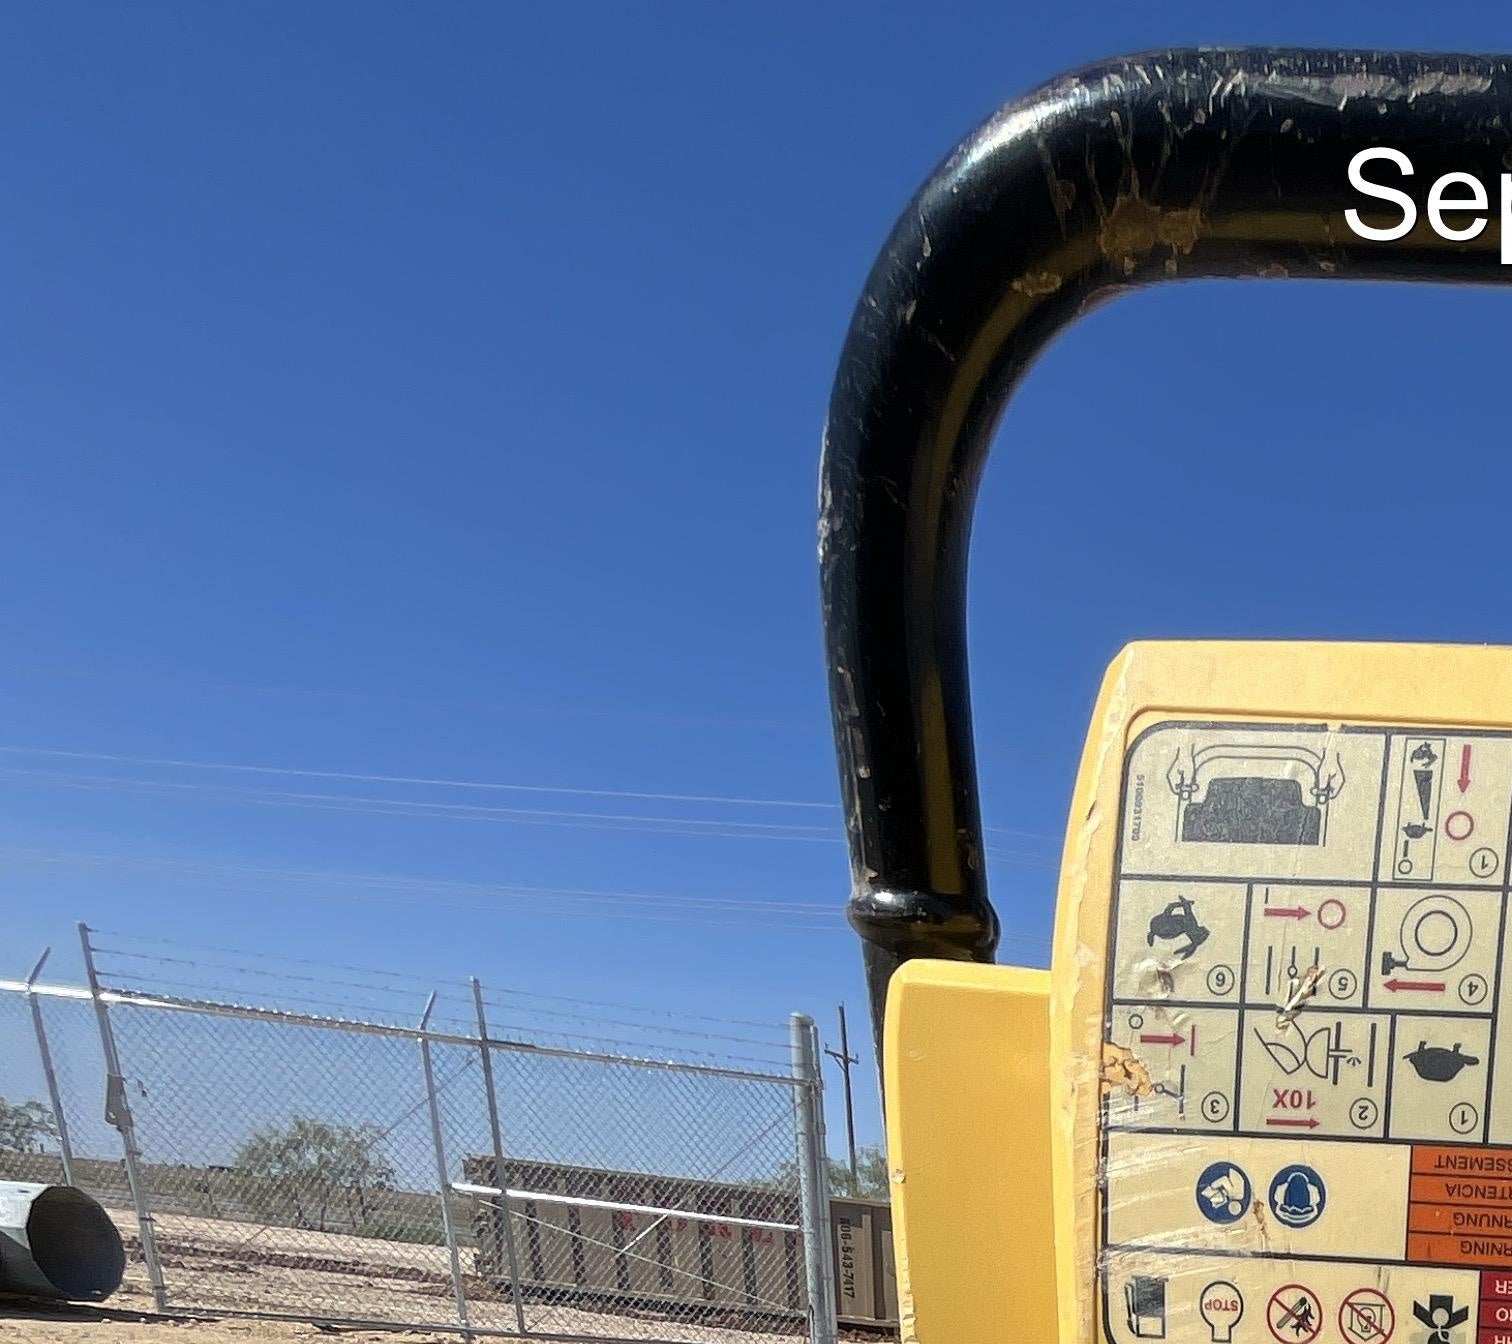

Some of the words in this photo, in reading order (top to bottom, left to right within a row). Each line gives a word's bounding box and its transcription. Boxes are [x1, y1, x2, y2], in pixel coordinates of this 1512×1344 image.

[1215, 973, 1225, 987] 6
[1337, 976, 1348, 991] 5
[1467, 981, 1479, 997] 4
[1272, 1087, 1317, 1110] 10X
[1209, 1099, 1220, 1114] 3
[1358, 1105, 1368, 1121] 2
[1459, 1110, 1469, 1125] 1
[1204, 1298, 1239, 1311] STOP
